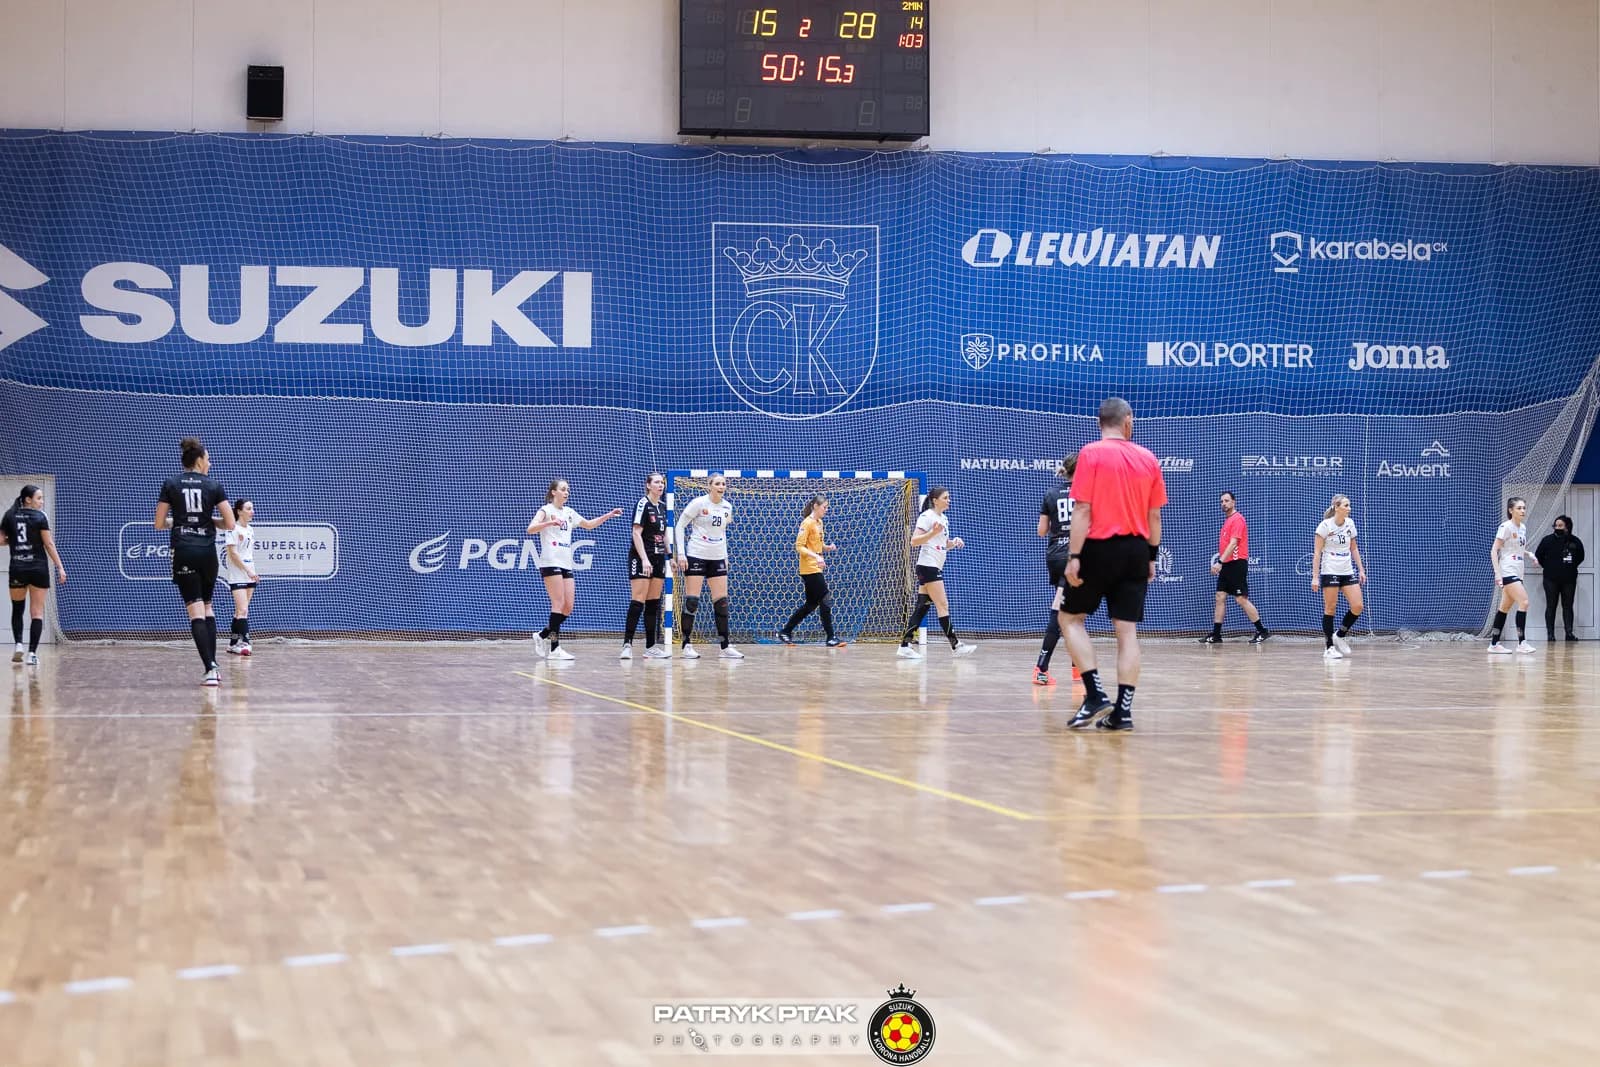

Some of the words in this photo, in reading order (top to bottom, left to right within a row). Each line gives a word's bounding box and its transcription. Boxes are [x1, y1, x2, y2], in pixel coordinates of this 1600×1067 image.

[902, 1, 923, 11] 2MIN
[752, 9, 778, 36] 15
[799, 18, 811, 37] 2
[839, 12, 876, 39] 28
[910, 17, 923, 29] 14
[898, 34, 923, 48] 1:03
[1015, 227, 1221, 269] LEWIATAN
[1310, 237, 1431, 261] karabela
[1432, 242, 1448, 252] CK
[80, 261, 592, 348] SUZUKI
[730, 301, 848, 395] CK
[998, 343, 1103, 362] PROFIKA
[1163, 341, 1314, 369] KOLPORTER
[1348, 342, 1450, 371] Joma
[1256, 456, 1343, 467] ALUTOR
[1377, 460, 1450, 477] Aswent
[182, 488, 203, 512] 10
[712, 516, 722, 527] 28
[17, 522, 27, 543] 3
[1337, 534, 1346, 544] 13
[253, 541, 327, 550] SUPERLIGA
[459, 539, 596, 571] PGNG
